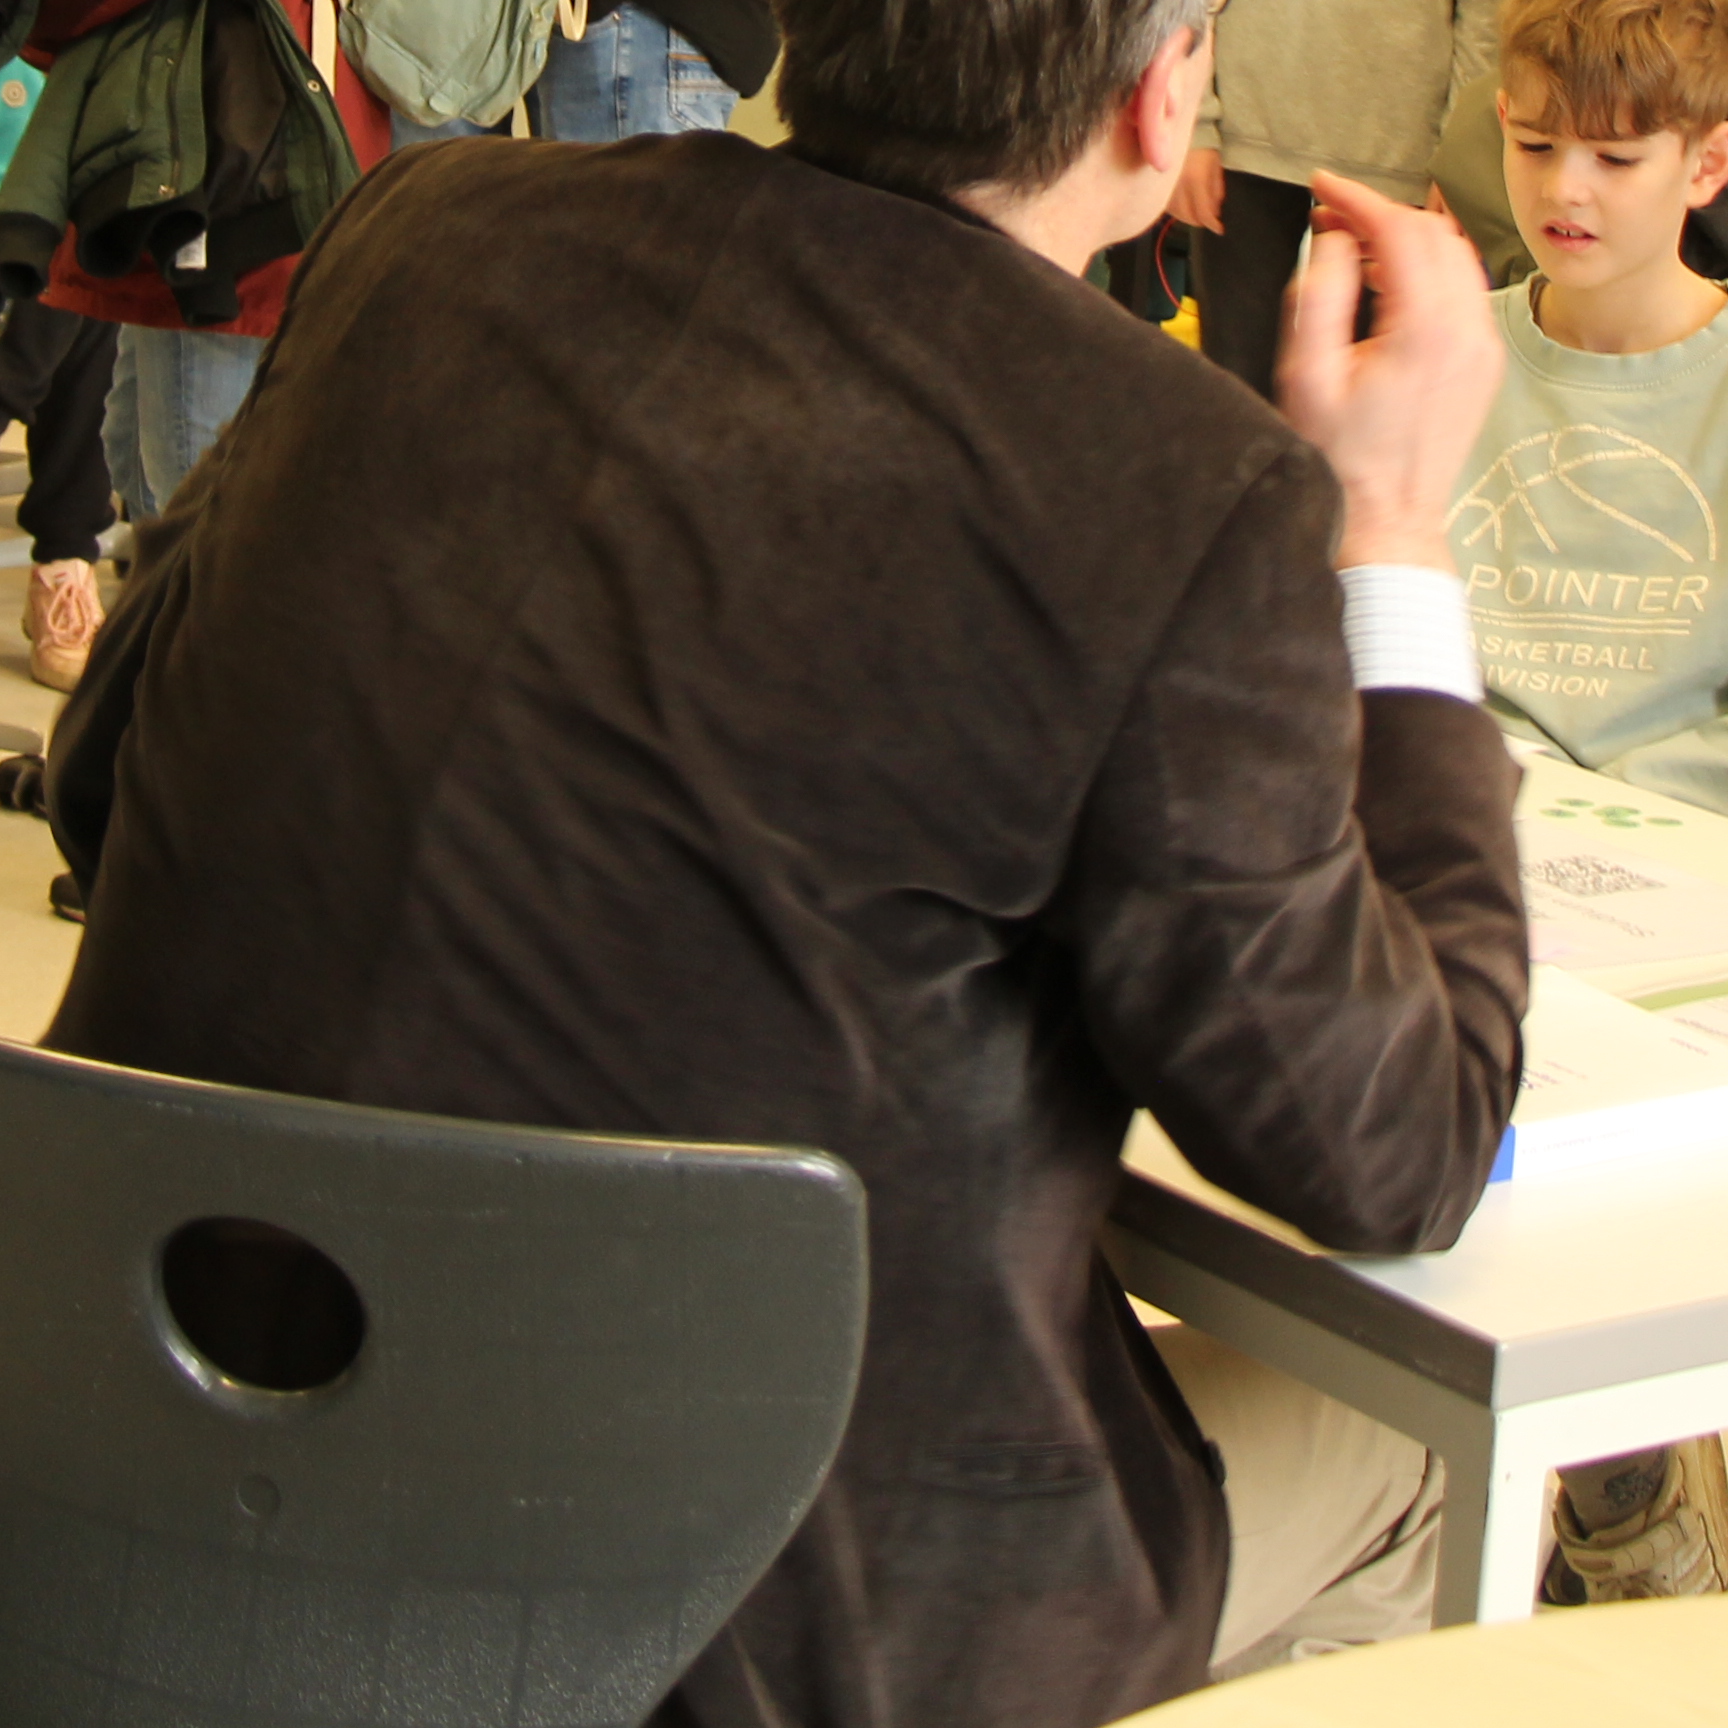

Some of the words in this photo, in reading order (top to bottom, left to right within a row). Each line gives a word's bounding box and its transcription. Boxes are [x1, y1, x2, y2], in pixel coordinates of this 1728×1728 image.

[1464, 562, 1710, 614] POINTER
[1470, 629, 1655, 672] SKETBALL
[1477, 663, 1611, 699] IVISION
